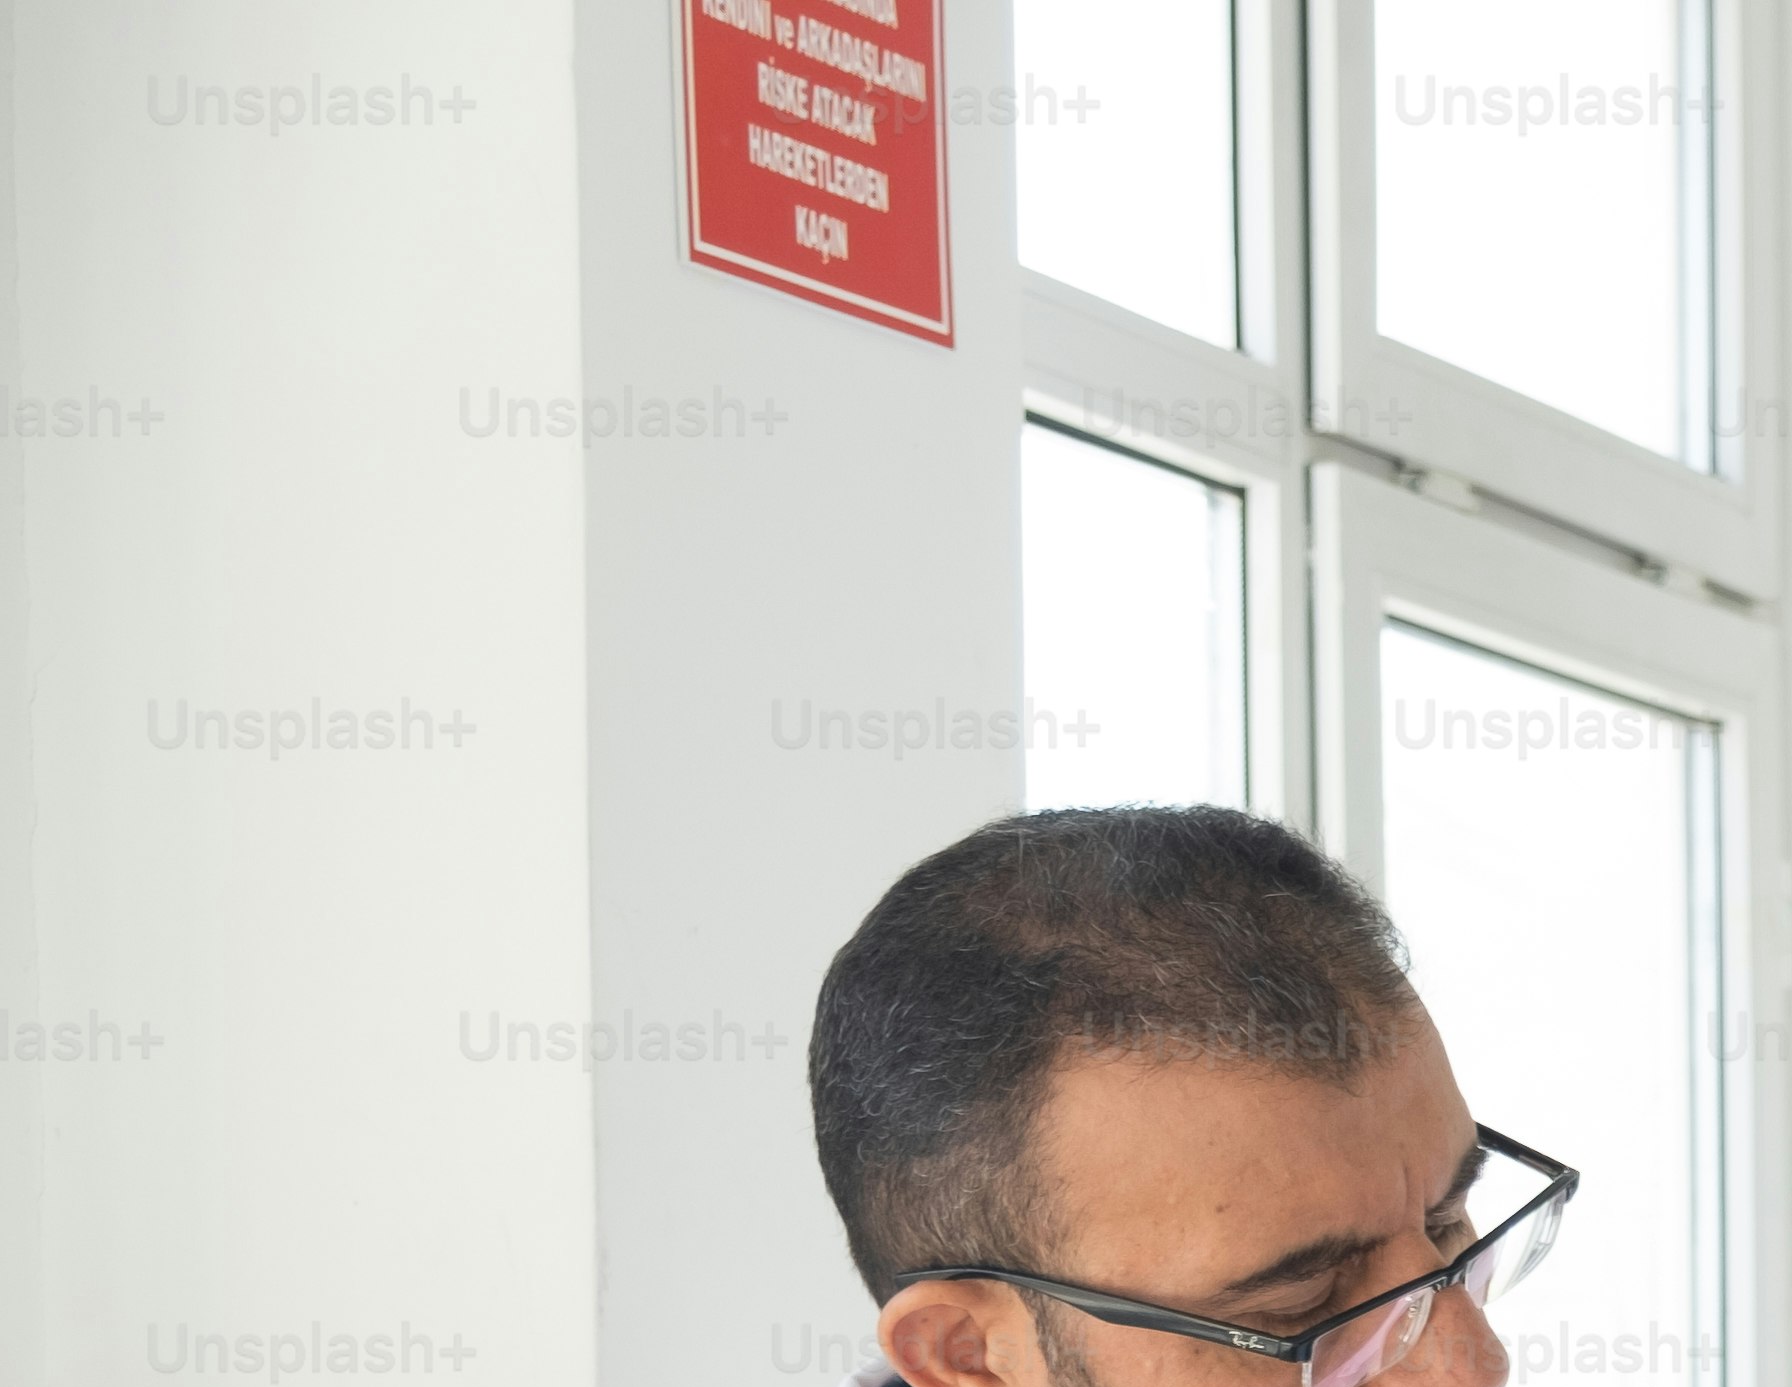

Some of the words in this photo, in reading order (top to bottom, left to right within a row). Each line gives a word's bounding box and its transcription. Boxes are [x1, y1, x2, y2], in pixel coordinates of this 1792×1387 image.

[757, 56, 809, 119] RİSKE
[811, 84, 877, 146] ATACAK
[797, 15, 926, 102] ARKADAŞLARINI
[748, 123, 889, 213] HAREKETLERDEN
[795, 205, 848, 265] KAÇIN
